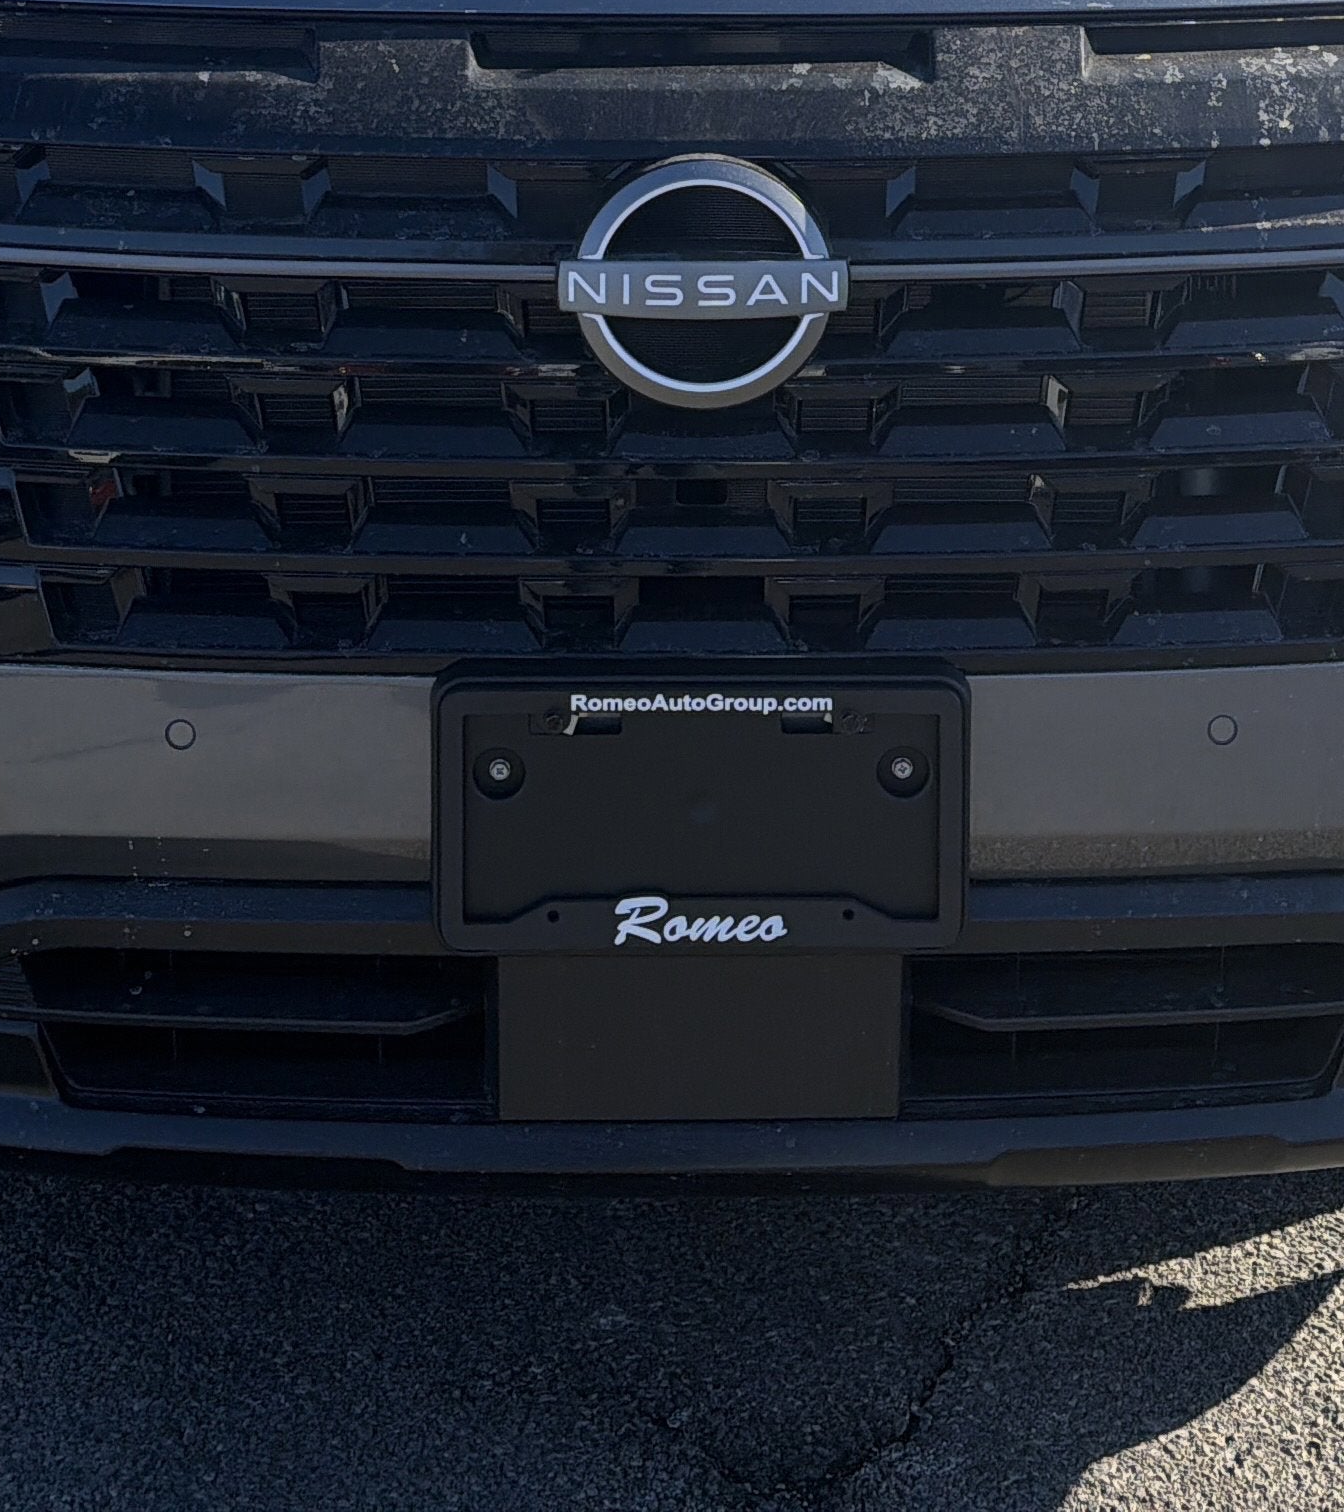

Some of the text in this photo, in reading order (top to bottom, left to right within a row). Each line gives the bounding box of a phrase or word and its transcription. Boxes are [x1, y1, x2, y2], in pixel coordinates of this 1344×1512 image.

[567, 270, 839, 307] NISSAN
[570, 693, 834, 715] RomeoAutoGroup.com
[614, 896, 788, 946] Romeo
